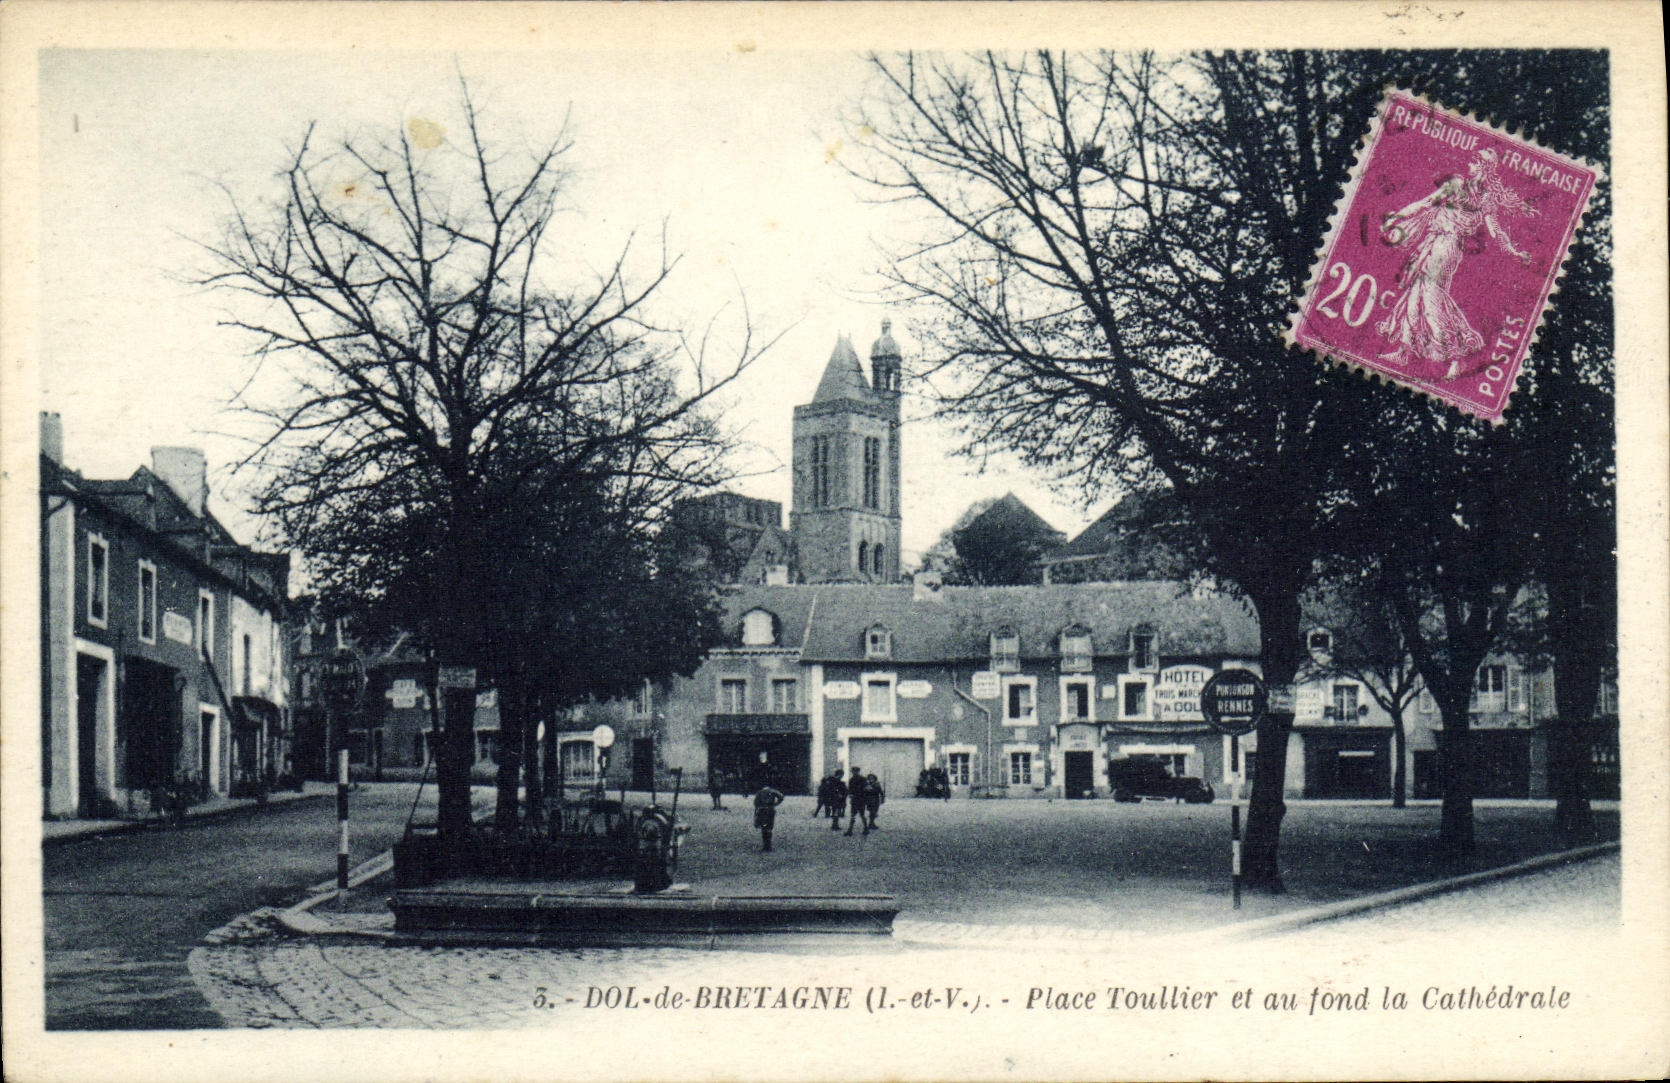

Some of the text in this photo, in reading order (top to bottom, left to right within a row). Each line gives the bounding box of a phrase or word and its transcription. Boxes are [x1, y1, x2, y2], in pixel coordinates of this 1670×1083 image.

[1501, 150, 1582, 195] FRANÇAISE
[1478, 314, 1525, 398] POSTES
[1217, 700, 1254, 713] RENNES
